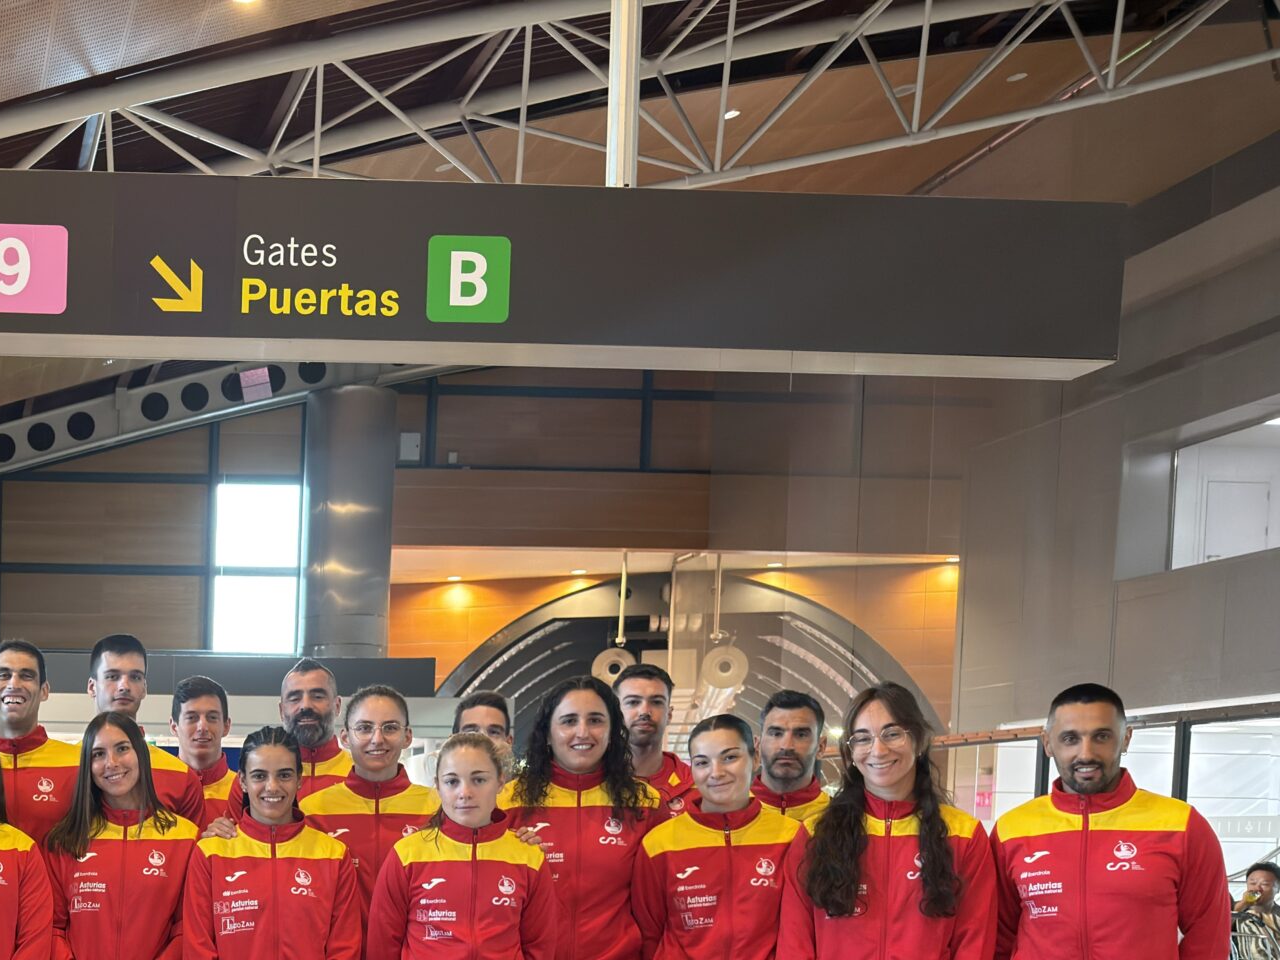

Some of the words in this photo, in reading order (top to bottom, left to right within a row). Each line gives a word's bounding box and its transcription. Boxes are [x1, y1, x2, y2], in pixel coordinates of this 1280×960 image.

[243, 234, 337, 267] Gates
[449, 250, 488, 307] B
[240, 278, 400, 317] Puertas
[1028, 882, 1062, 891] Asturias
[231, 899, 258, 907] Asturias
[687, 895, 717, 903] Asturias
[428, 909, 456, 917] Asturias
